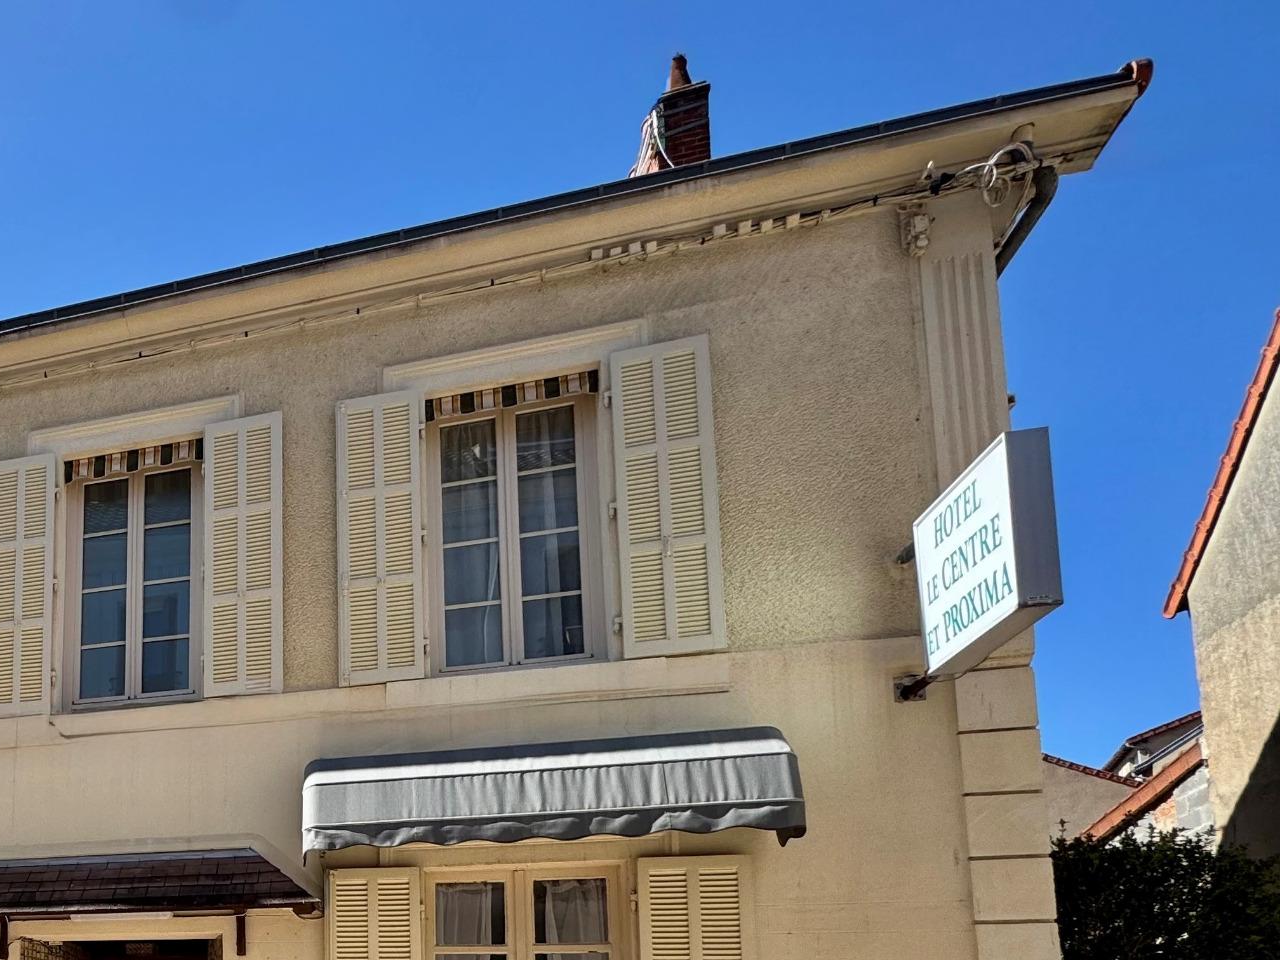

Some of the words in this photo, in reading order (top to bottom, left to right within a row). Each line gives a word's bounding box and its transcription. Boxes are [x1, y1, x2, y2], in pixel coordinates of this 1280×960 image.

[926, 573, 940, 606] LE
[941, 512, 1003, 591] CENTRE
[933, 479, 982, 549] HOTEL
[926, 624, 940, 657] ET
[942, 561, 1014, 643] PROXIMA
